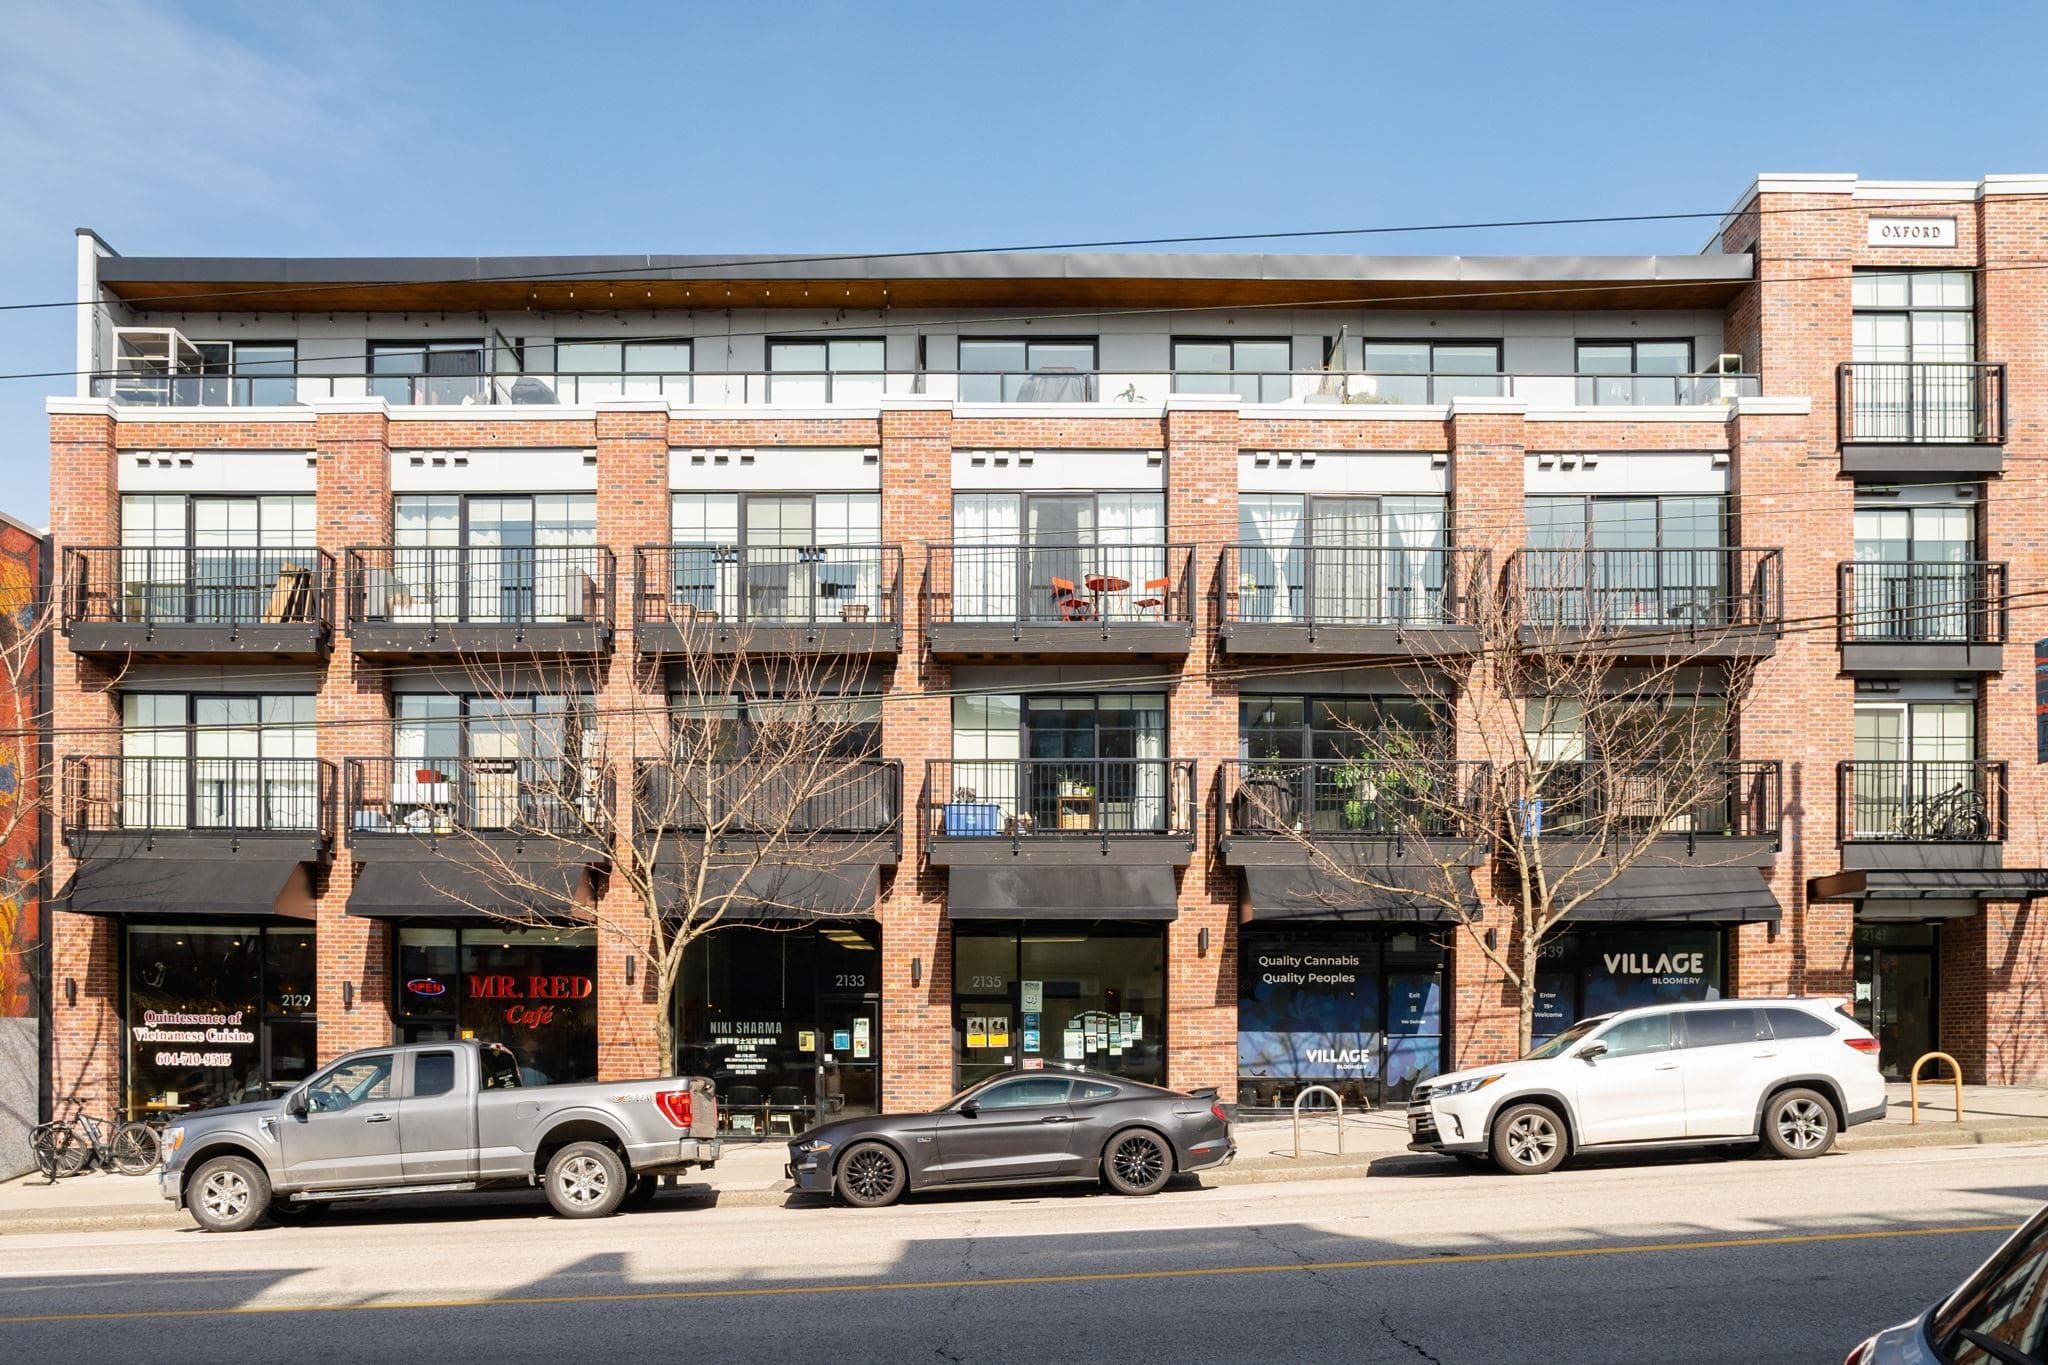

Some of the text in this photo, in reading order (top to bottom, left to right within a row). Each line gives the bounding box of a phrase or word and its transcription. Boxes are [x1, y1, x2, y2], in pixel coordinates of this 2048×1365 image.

[1882, 225, 1941, 238] OXFORD
[1258, 955, 1360, 968] Quality Cannabis
[1603, 953, 1704, 974] VILLAGE
[835, 974, 865, 987] 2133
[972, 975, 1002, 988] 2135
[1262, 973, 1356, 985] Quality Peoples
[1652, 977, 1700, 985] BLOOMERY
[408, 983, 442, 993] OPEN
[468, 975, 593, 999] MR. RED
[282, 994, 311, 1007] 2129
[144, 1009, 243, 1027] Quintessence of
[505, 1005, 555, 1029] Café
[710, 1021, 782, 1034] NIKI SHARMA
[132, 1027, 255, 1043] Vietnamese Cuisine
[1306, 1049, 1370, 1063] VILLAGE
